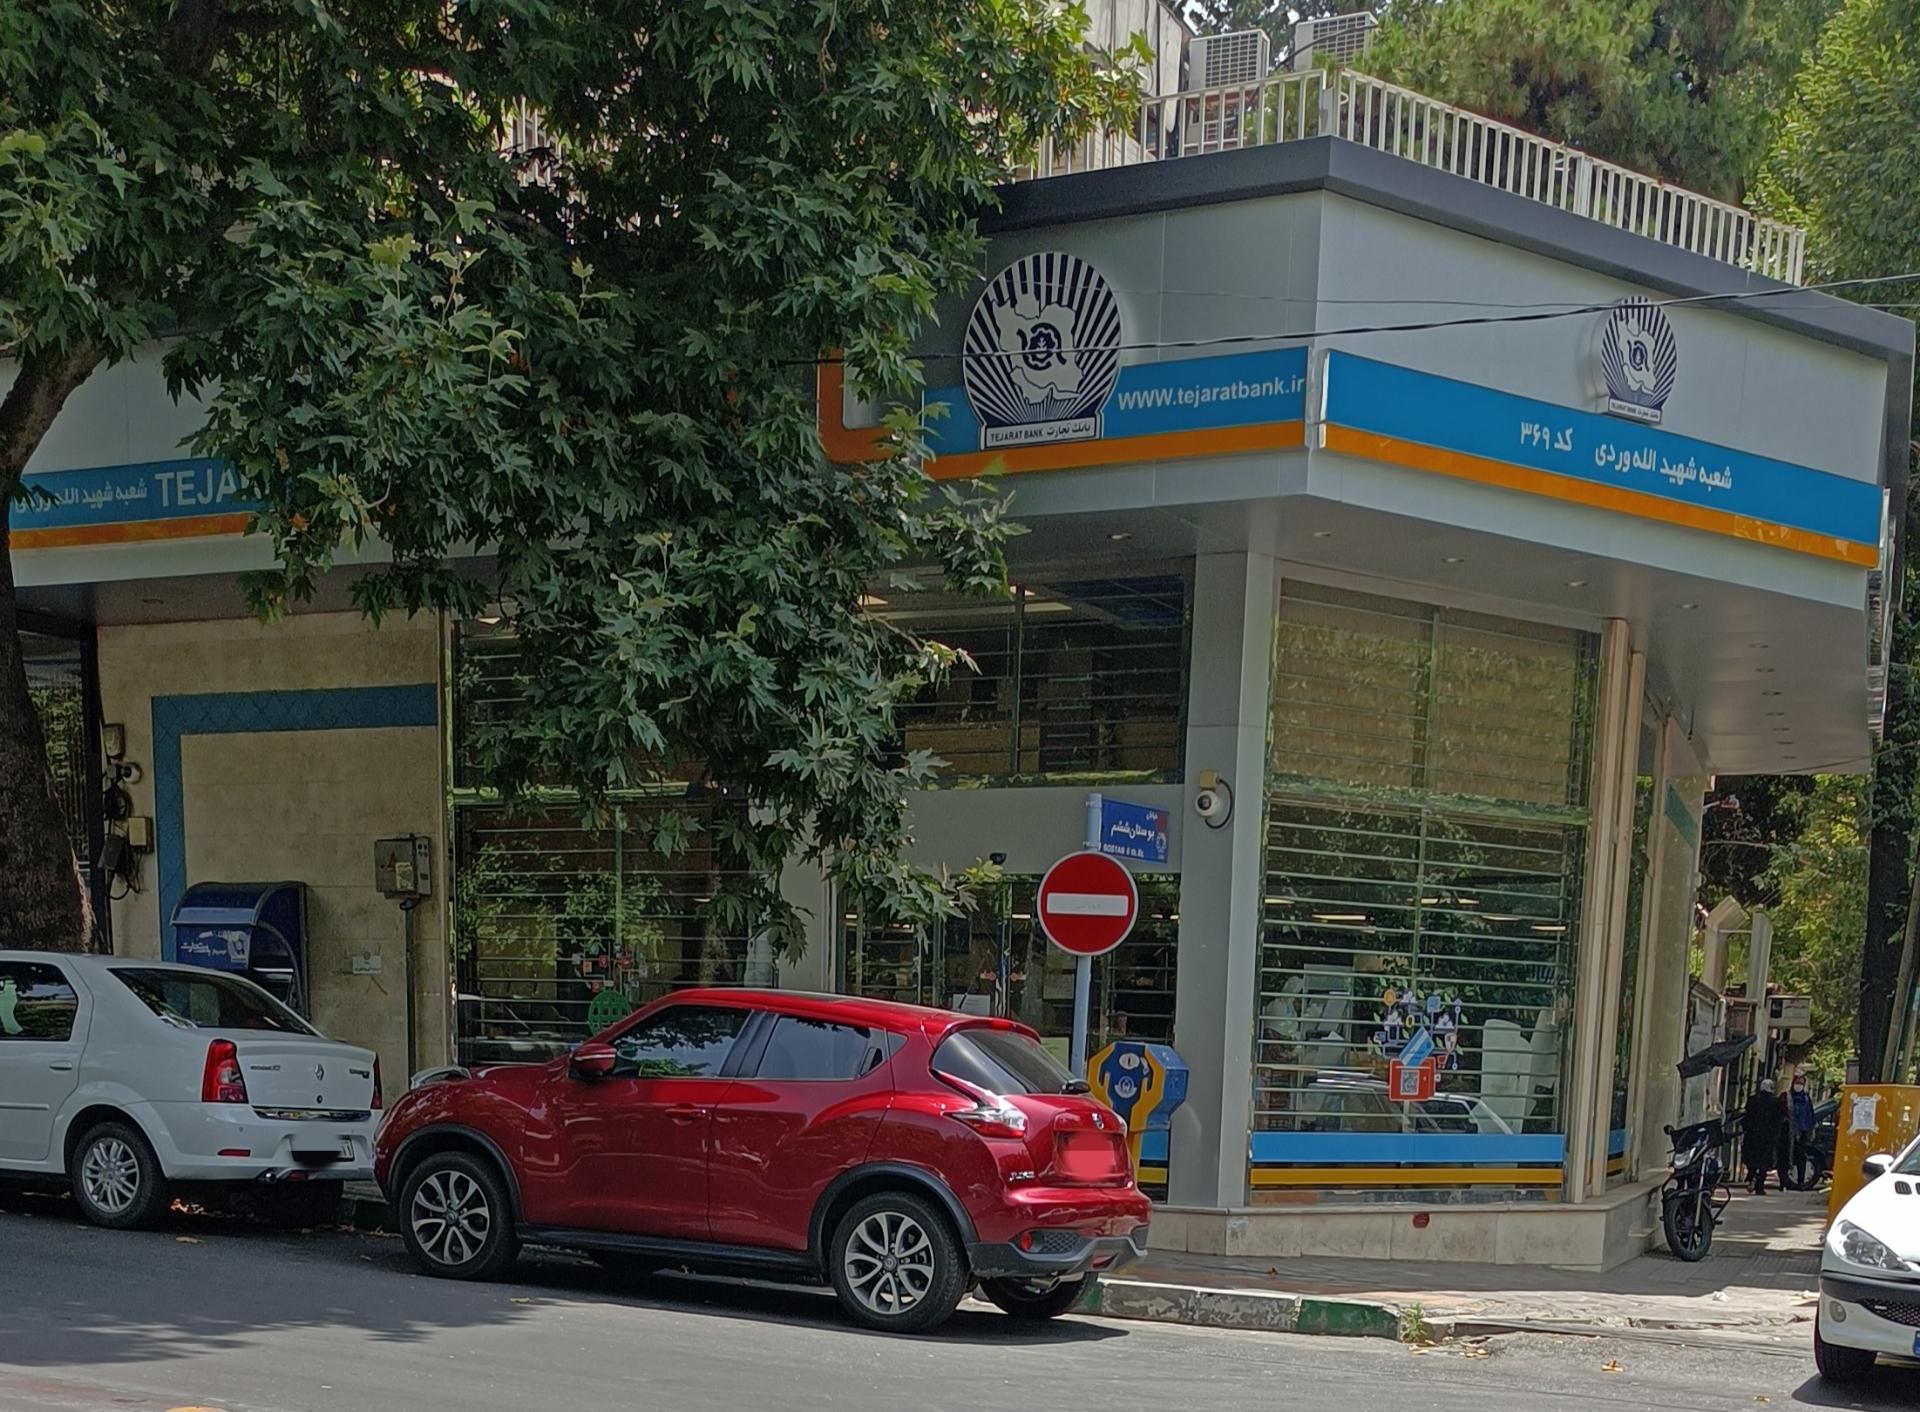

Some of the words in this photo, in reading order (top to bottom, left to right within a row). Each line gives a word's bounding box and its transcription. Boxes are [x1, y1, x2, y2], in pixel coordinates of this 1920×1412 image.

[991, 430, 1023, 442] TEJARAT
[1023, 428, 1043, 440] BANK
[1046, 422, 1070, 438] تجارت
[1519, 420, 1551, 451] ۳۶۹
[1553, 426, 1574, 451] کد
[1659, 455, 1697, 486] شهید
[1698, 465, 1733, 492] شعبه
[82, 480, 114, 509] شهید
[115, 477, 148, 506] شعبه
[1110, 820, 1130, 837] ششم
[1128, 822, 1155, 842] بوستان
